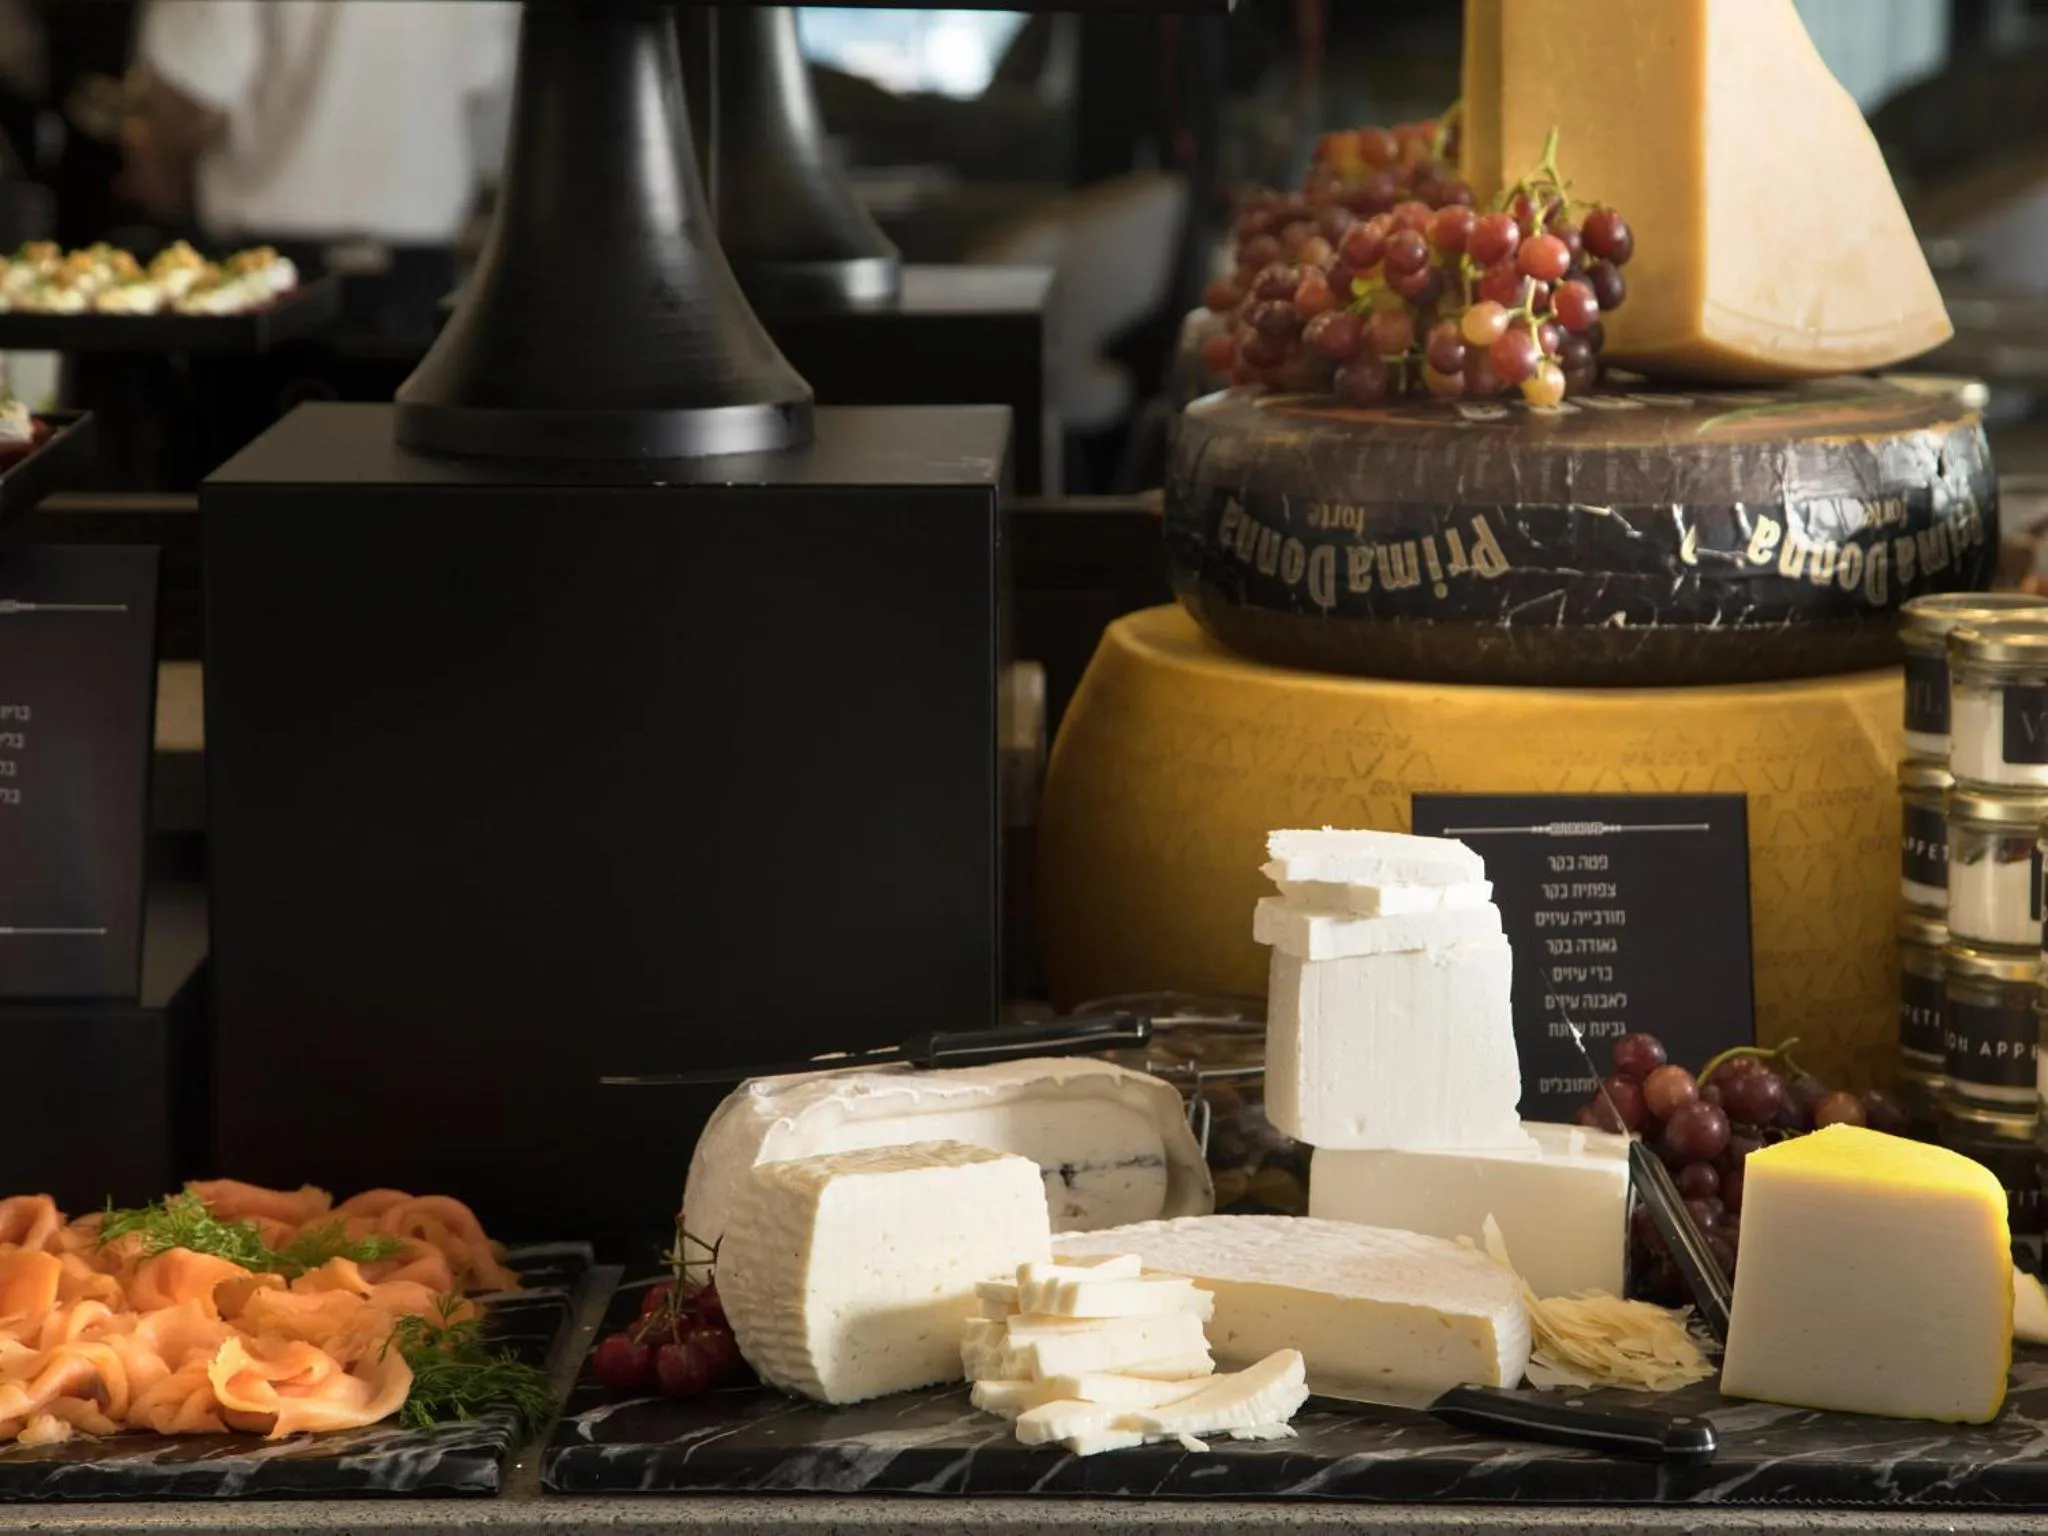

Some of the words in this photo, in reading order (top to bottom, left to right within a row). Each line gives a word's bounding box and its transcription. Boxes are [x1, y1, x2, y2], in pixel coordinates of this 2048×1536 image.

[1307, 503, 1366, 536] forte
[1219, 496, 1337, 608] Donna
[1348, 514, 1510, 599] Prima
[1748, 514, 1888, 606] Donna
[1547, 855, 1575, 873] בקר
[1540, 883, 1568, 901] בקר
[1545, 938, 1573, 956] בקר
[1552, 966, 1588, 983] עיזים
[1589, 966, 1614, 981] ברי
